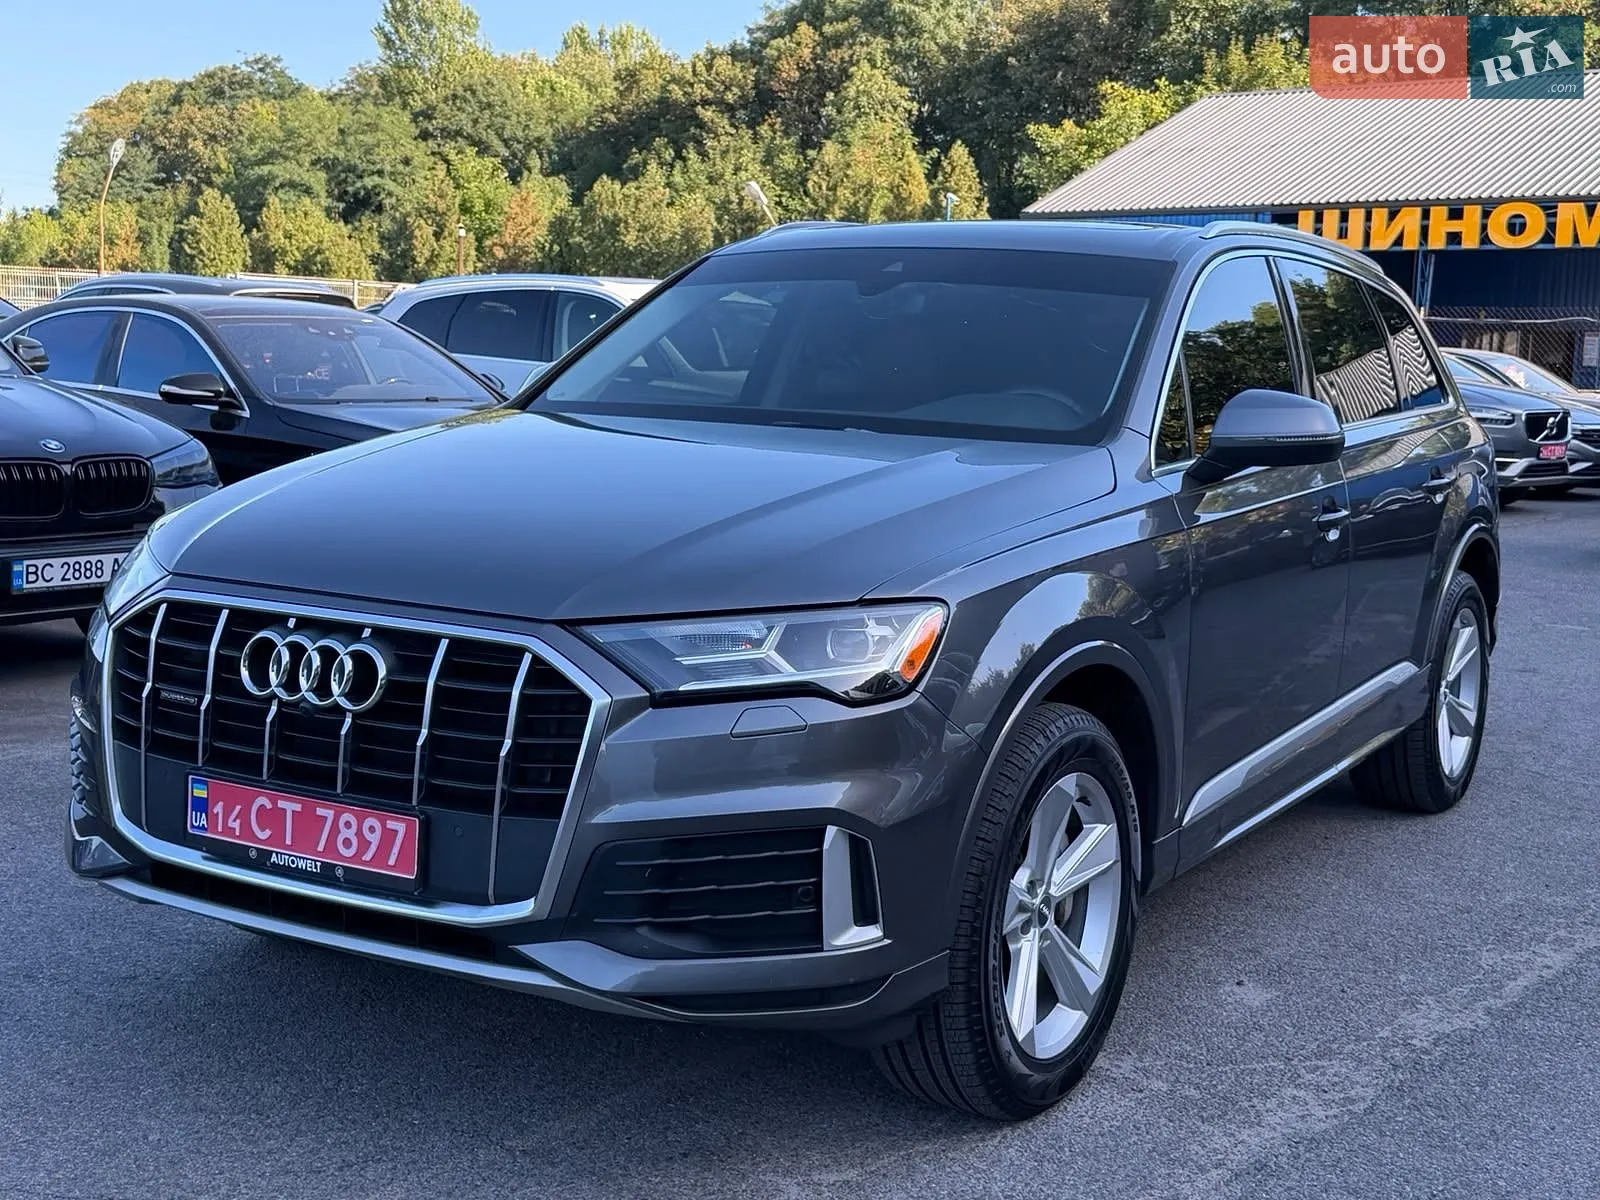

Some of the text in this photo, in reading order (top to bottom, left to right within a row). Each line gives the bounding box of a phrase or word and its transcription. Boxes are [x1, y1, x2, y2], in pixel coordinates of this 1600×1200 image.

[25, 562, 54, 585] BC
[60, 559, 104, 582] 2888
[191, 811, 208, 828] UA
[315, 806, 407, 866] 7897
[270, 852, 322, 873] AUTOWELT
